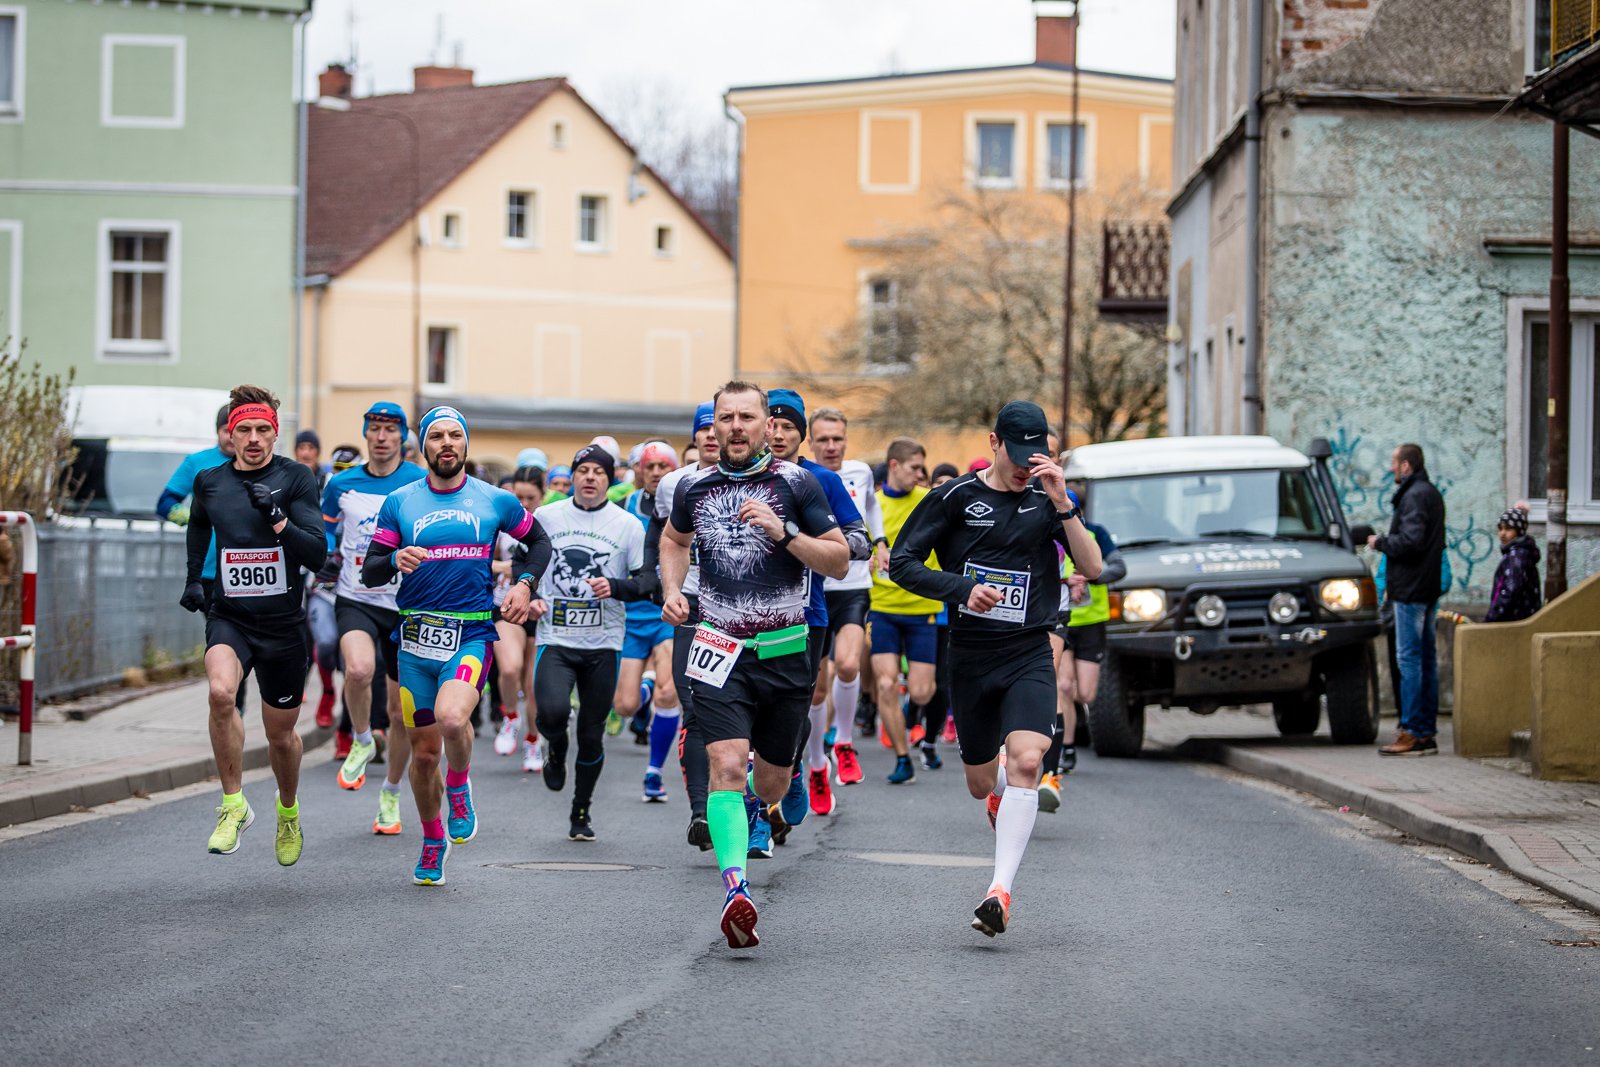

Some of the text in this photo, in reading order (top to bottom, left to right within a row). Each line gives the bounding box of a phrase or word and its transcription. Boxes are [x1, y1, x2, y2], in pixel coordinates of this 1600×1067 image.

[413, 509, 481, 545] BEZSPINY
[230, 552, 274, 561] DATASPORT
[428, 546, 483, 559] ASHRADE
[229, 566, 277, 587] 3960
[988, 584, 1022, 607] 16
[568, 610, 598, 625] 277
[420, 627, 454, 647] 453
